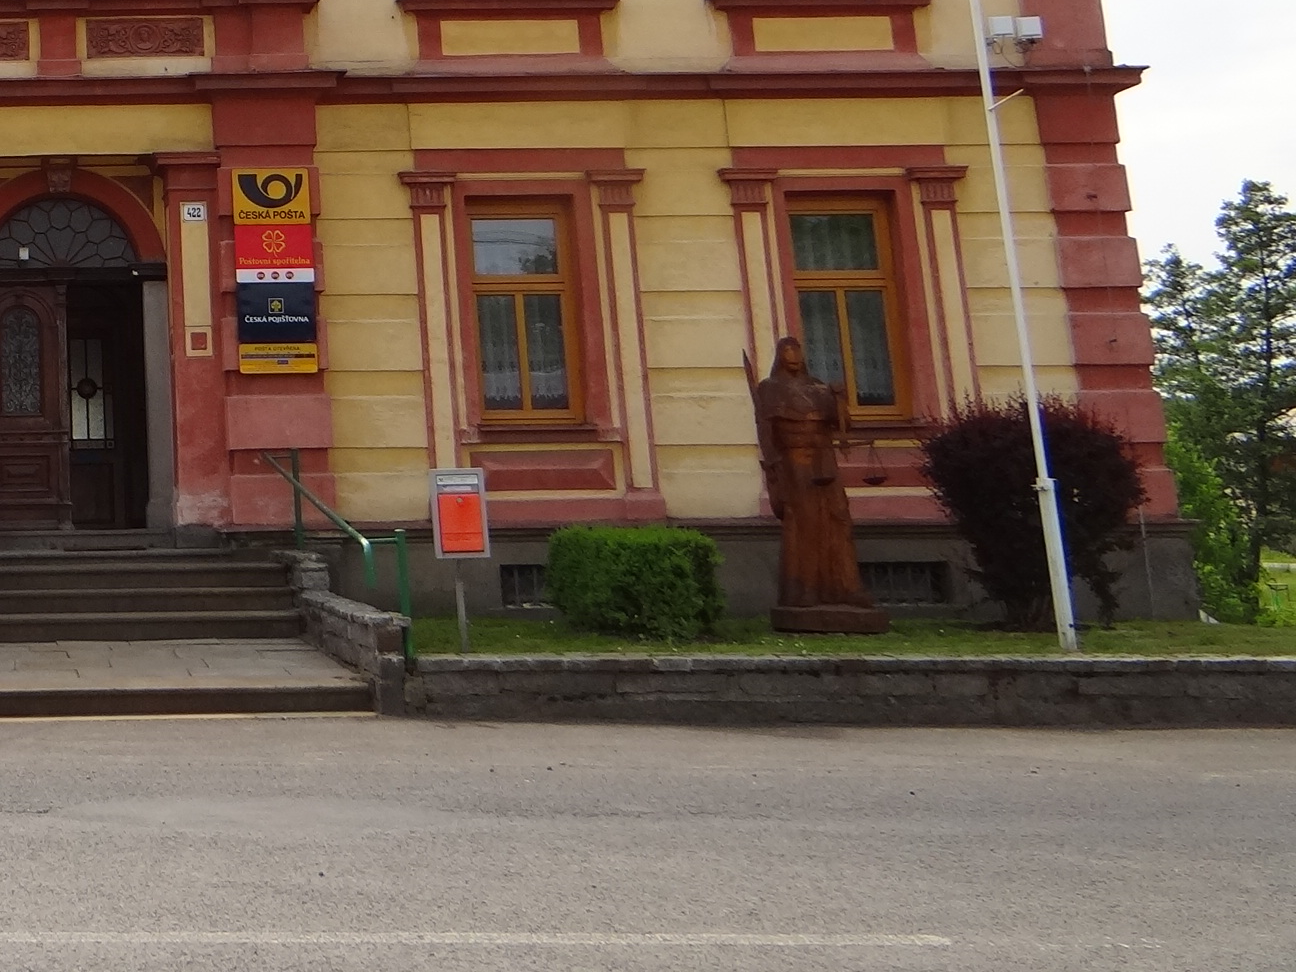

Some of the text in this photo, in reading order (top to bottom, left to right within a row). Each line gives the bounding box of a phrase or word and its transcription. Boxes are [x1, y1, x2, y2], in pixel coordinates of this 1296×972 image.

[186, 207, 202, 218] 422
[238, 208, 306, 220] ČESKÁ POŠTA
[239, 256, 311, 266] Poštovní spořitelna
[244, 314, 309, 323] ČESKÁ POJIŠŤOVNA
